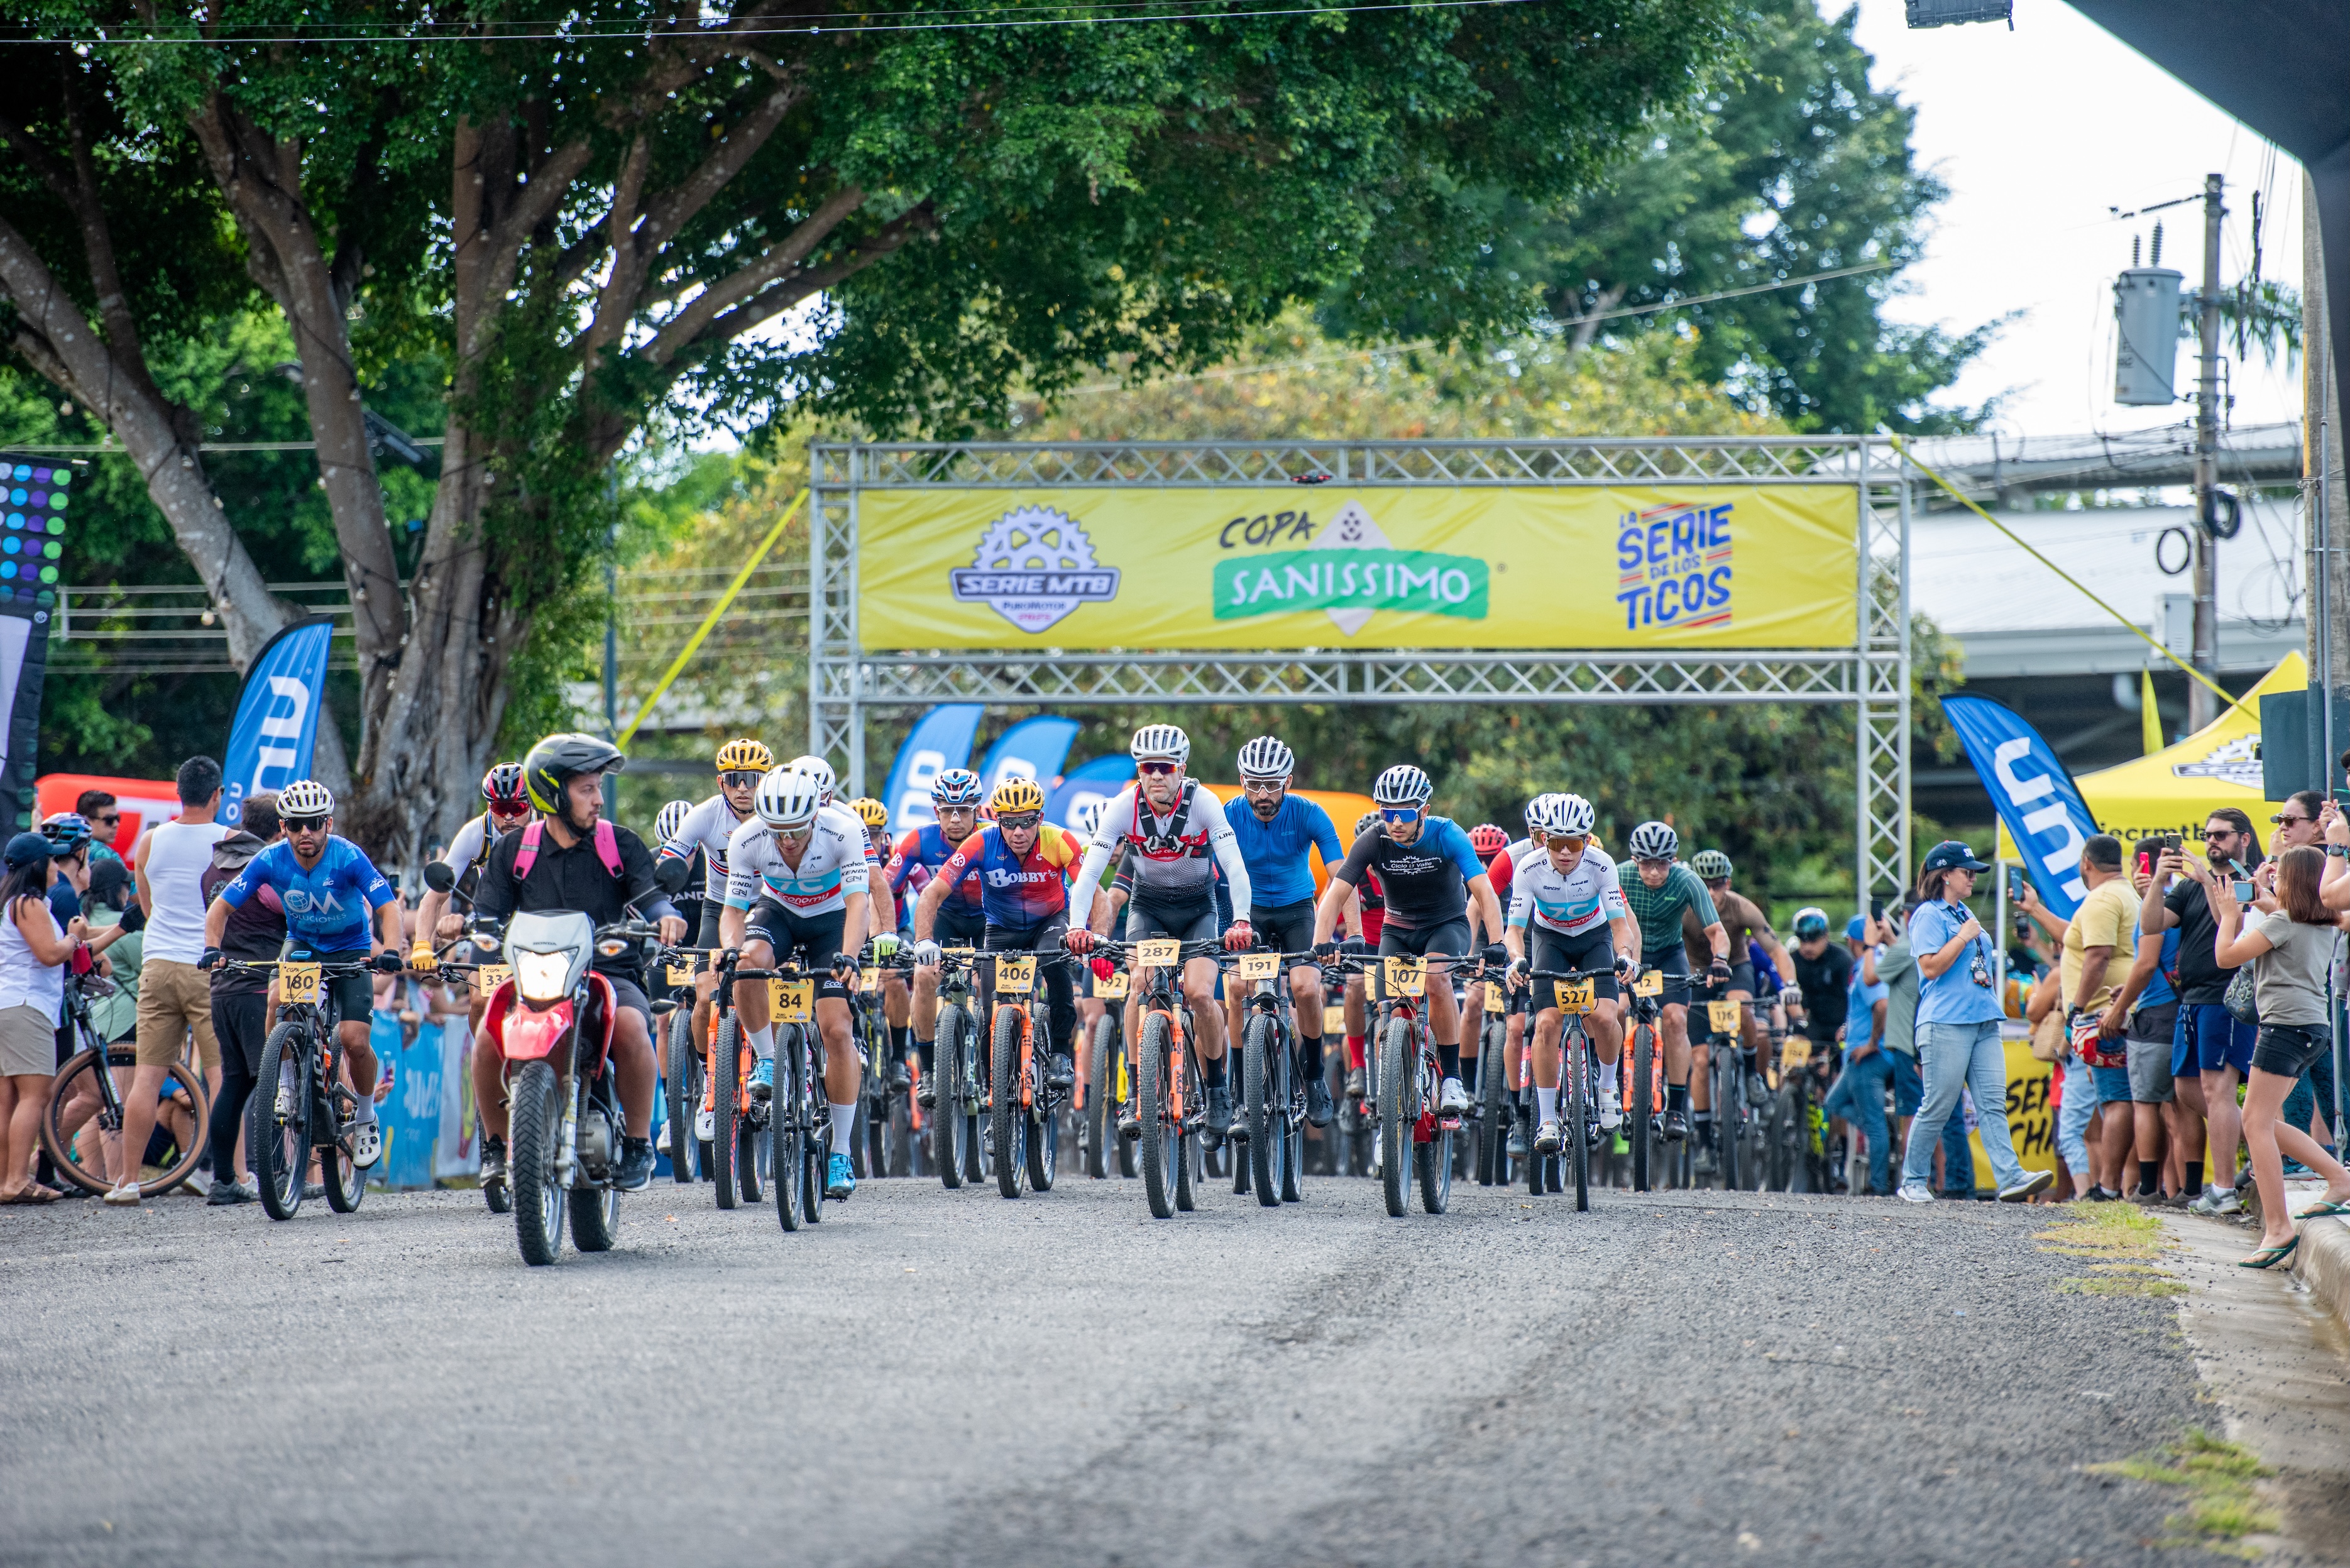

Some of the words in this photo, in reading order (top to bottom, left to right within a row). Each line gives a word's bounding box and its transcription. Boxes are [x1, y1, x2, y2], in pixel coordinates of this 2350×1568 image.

[1619, 510, 1637, 529] LA
[1219, 511, 1318, 549] COPA
[1617, 503, 1733, 570] SERIE
[1649, 564, 1670, 580] DE
[1674, 554, 1701, 574] LOS
[962, 574, 1046, 594] SERIE
[1047, 574, 1112, 594] MTB
[1231, 562, 1471, 606] SANISSIMO
[1616, 566, 1733, 631] TICOS
[820, 826, 838, 838] SPONSER
[741, 833, 761, 849] SPONSER
[841, 861, 865, 870] wahoo
[1523, 862, 1541, 874] SPONSER
[1583, 858, 1601, 867] SPONSER
[729, 880, 752, 889] KENDA
[986, 868, 1058, 887] BOBBY'S
[370, 878, 385, 892] BC
[288, 910, 347, 923] SOLUCIONES
[1142, 947, 1174, 957] 287
[1248, 962, 1271, 971] 191
[999, 968, 1030, 980] 406
[1392, 969, 1420, 983] 107
[285, 975, 314, 989] 180
[779, 993, 802, 1009] 84
[1562, 990, 1588, 1004] 527
